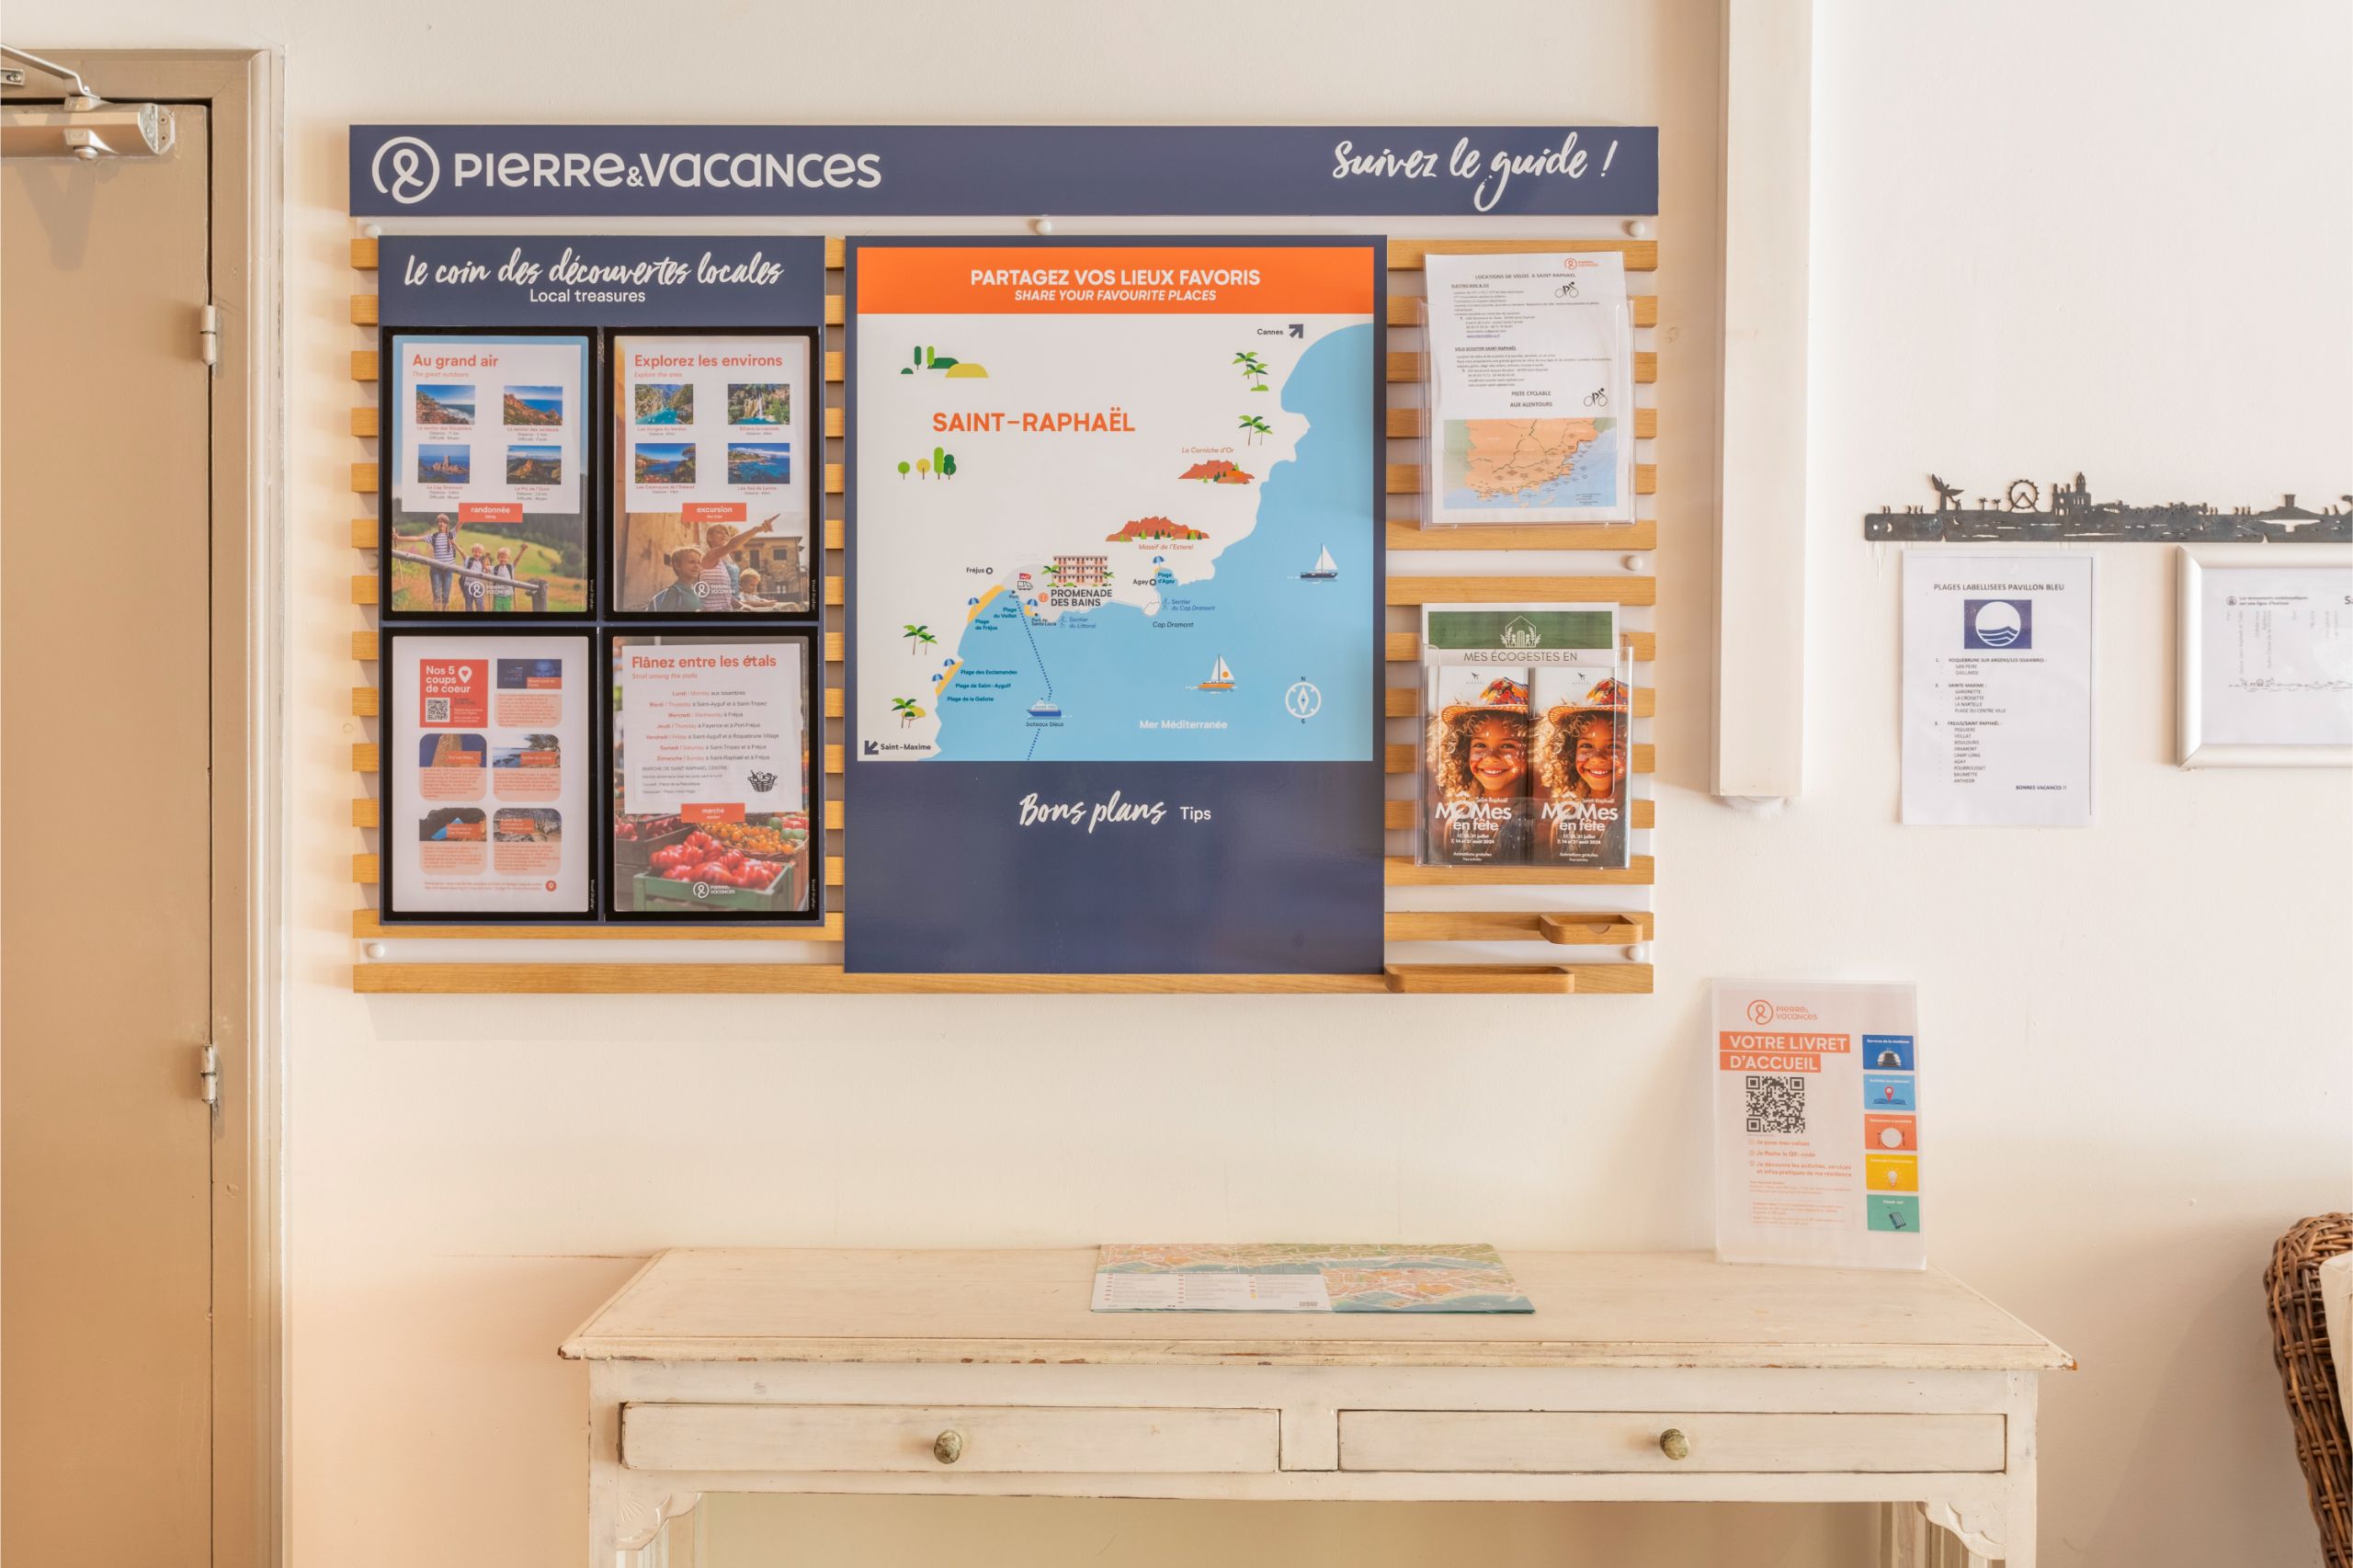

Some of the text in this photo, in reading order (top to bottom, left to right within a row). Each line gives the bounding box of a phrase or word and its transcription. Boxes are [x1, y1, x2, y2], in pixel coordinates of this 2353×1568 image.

[1333, 131, 1619, 211] Suivez le guide !
[404, 247, 784, 286] Le coin des découvertes locales
[971, 269, 1262, 287] PARTAGEZ VOS LIEUX FAVORIS
[529, 288, 647, 303] Local treasures
[1014, 290, 1217, 302] SHARE YOUR FAVOURITE PLACES
[1256, 328, 1284, 336] Cannes
[412, 354, 499, 370] Au grand air
[634, 354, 783, 370] Explorez les environs
[471, 506, 511, 514] randonnée
[697, 506, 733, 514] excursion
[966, 567, 985, 575] Fréjus
[1132, 579, 1149, 587] Agay
[1051, 589, 1113, 598] PROMENADE
[1051, 598, 1101, 608] DES BAINS
[1153, 621, 1165, 630] Cap
[631, 654, 777, 669] Flânez entre les étals
[1463, 649, 1578, 662] MES ÉCOGESTES EN
[426, 665, 455, 676] Nos 5
[426, 676, 457, 687] coups
[426, 684, 472, 694] de coeur
[1139, 719, 1228, 730] Mer Méditerranée
[1019, 790, 1211, 834] Bons plans Tips
[1453, 818, 1500, 832] en fête
[1560, 818, 1607, 832] en fête
[1730, 1035, 1847, 1051] VOTRE LIVRET
[1729, 1054, 1819, 1071] D'ACCUEIL
